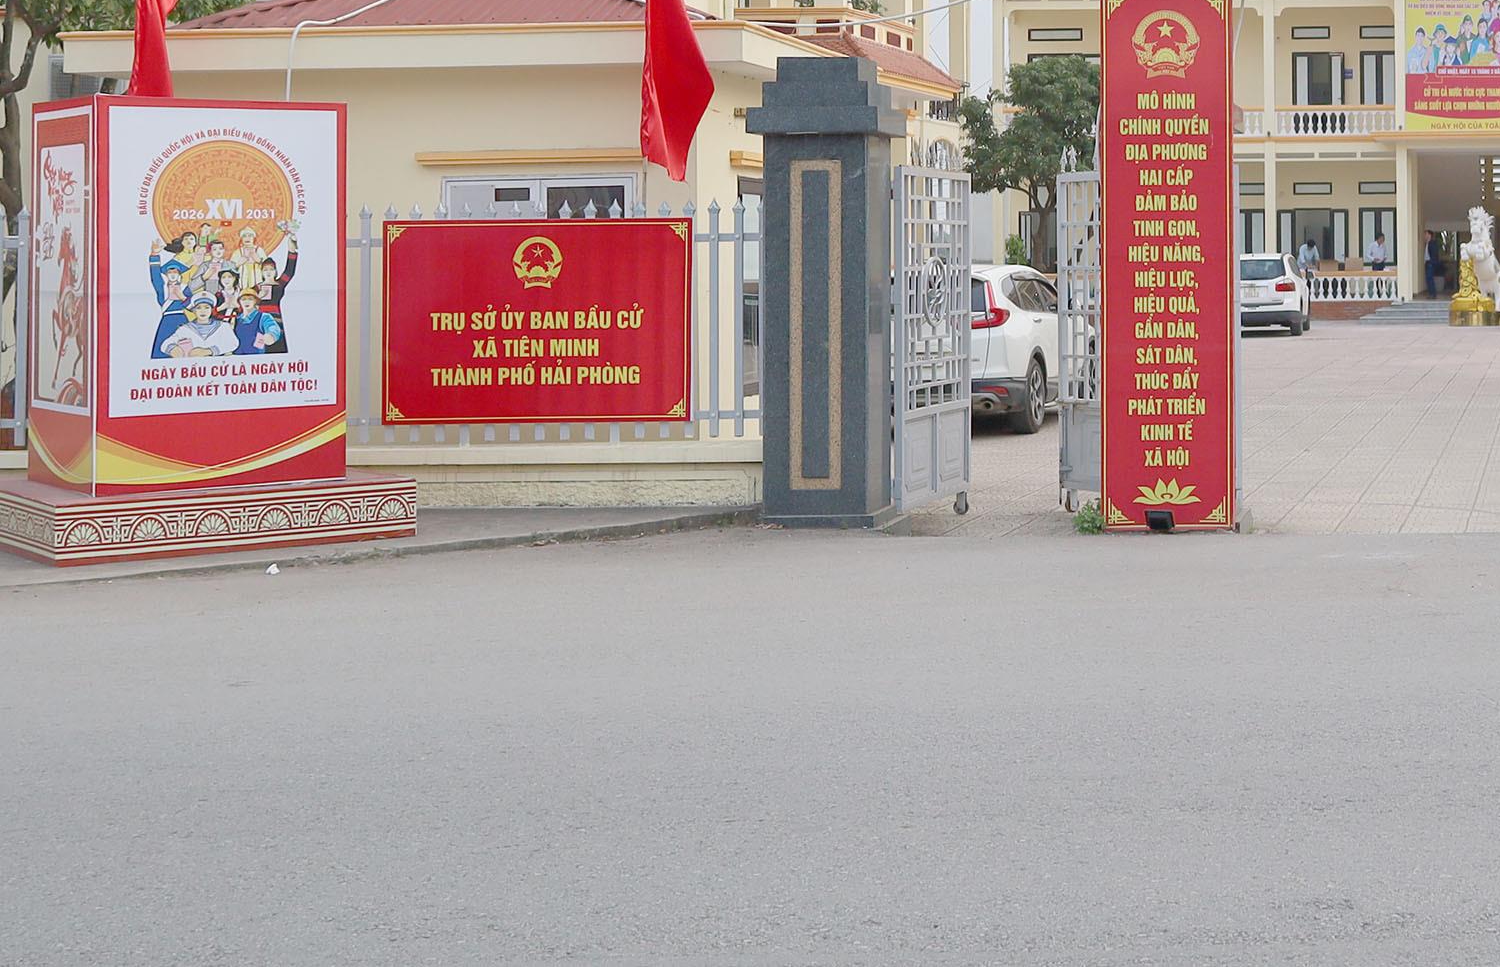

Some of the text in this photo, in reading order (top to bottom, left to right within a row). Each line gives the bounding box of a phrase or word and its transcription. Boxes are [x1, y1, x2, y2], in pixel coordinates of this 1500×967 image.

[1138, 90, 1195, 110] MÔ HÌNH
[1120, 114, 1208, 136] CHÍNH QUYỀN
[1126, 143, 1207, 164] ĐỊA PHƯƠNG
[1140, 164, 1193, 185] HAI CẤP
[173, 199, 276, 220] 2026 XVI 2031
[1136, 190, 1197, 211] ĐẢM BẢO
[1133, 220, 1199, 240] TINH GỌN,
[1129, 242, 1204, 265] HIỆU NĂNG,
[1135, 268, 1198, 291] HIỆU LỰC,
[1134, 291, 1199, 317] HIỆU QUẢ,
[431, 303, 644, 334] TRỤ SỞ ỦY BAN BẦU CỬ
[1135, 317, 1198, 340] GẦN DÂN,
[473, 336, 599, 357] XÃ TIÊN MINH
[1137, 344, 1197, 365] SÁT DÂN,
[431, 359, 640, 386] THÀNH PHỐ HẢI PHÒNG
[1135, 367, 1199, 389] THÚC ĐẨY
[1129, 392, 1205, 415] PHÁT TRIỂN
[1141, 419, 1193, 440] KINH TẾ
[1145, 447, 1189, 469] XÃ HỘI
